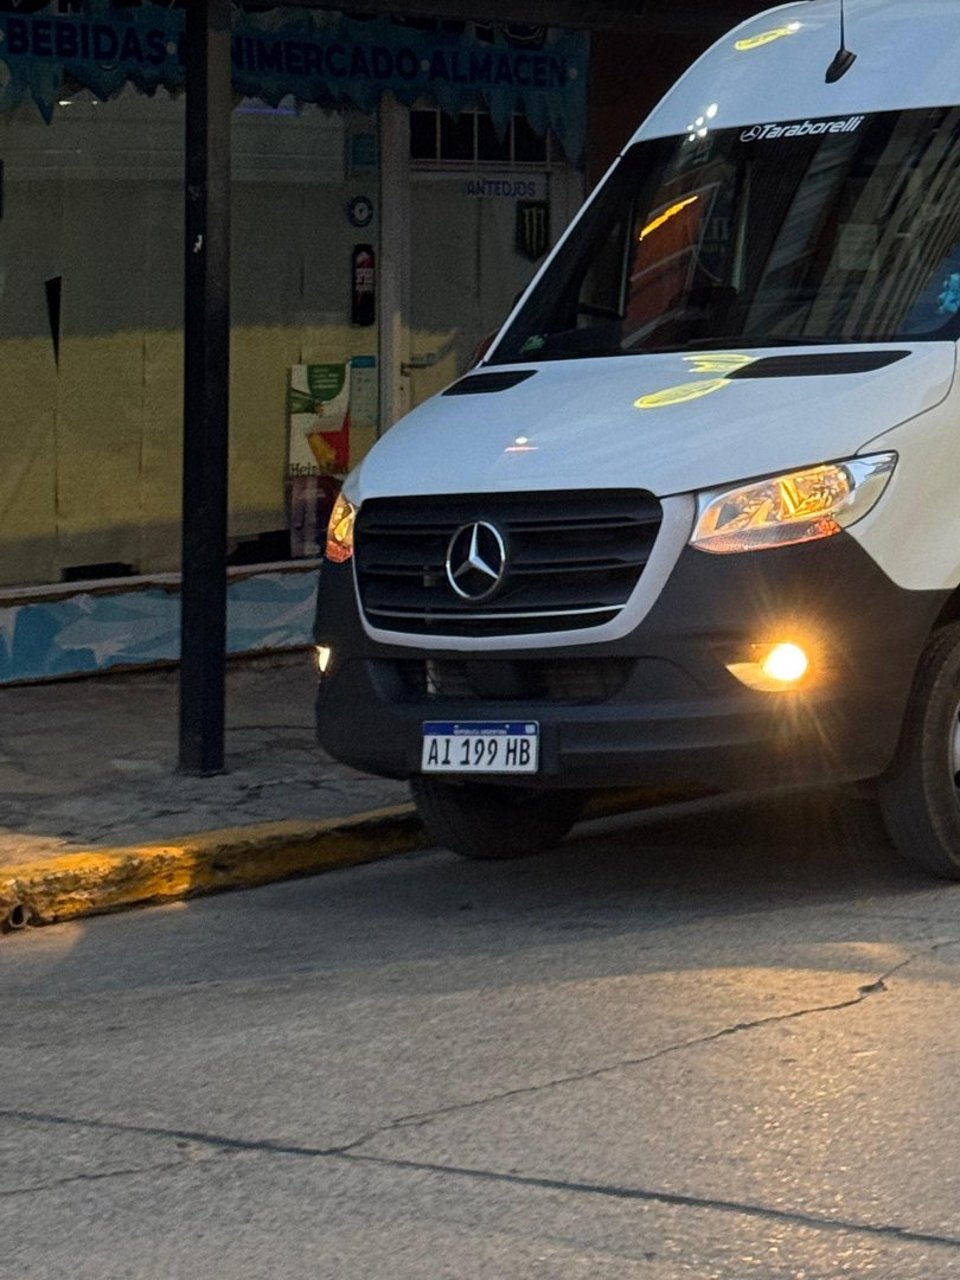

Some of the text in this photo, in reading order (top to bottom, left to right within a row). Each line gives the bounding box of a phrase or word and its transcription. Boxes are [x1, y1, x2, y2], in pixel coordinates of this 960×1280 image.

[8, 18, 167, 65] BEBIDAS
[430, 50, 567, 87] ALMACEN
[757, 116, 865, 140] Taraborelli
[427, 738, 531, 766] AI 199 HB
